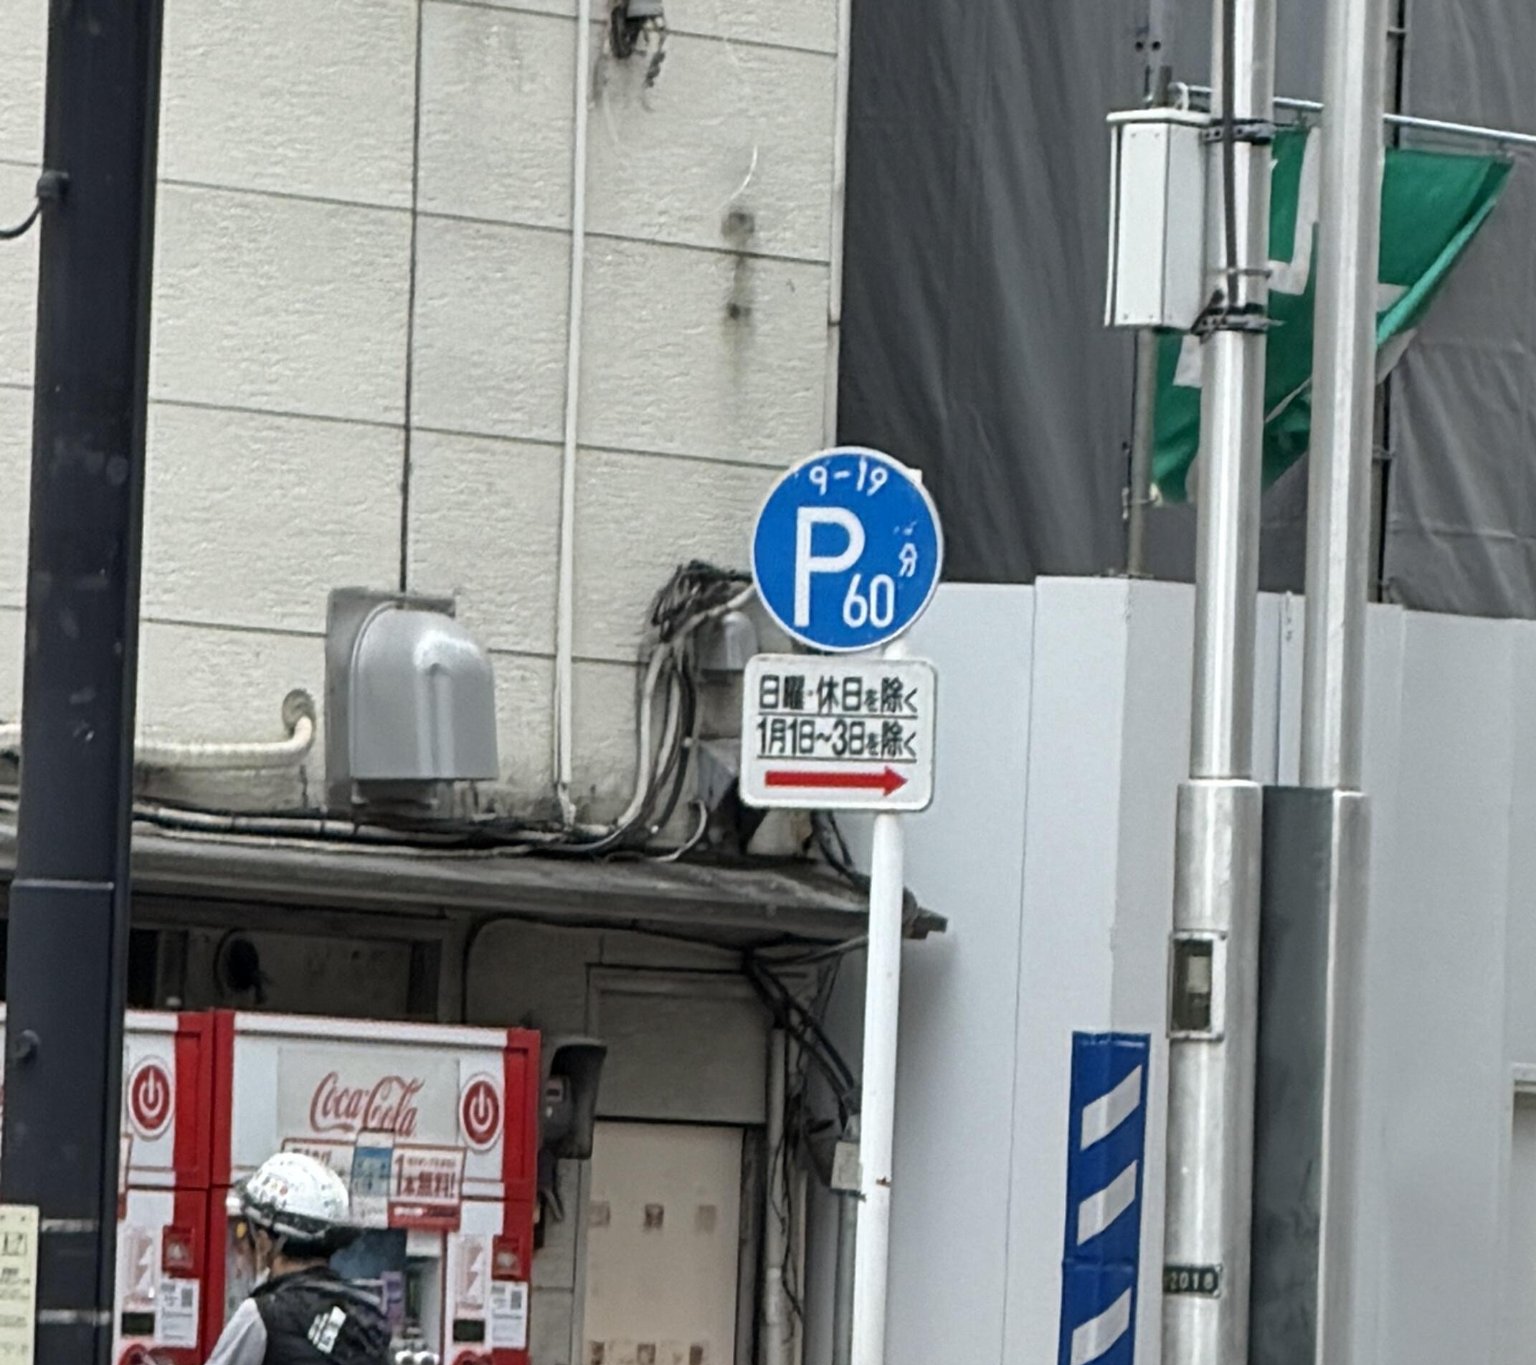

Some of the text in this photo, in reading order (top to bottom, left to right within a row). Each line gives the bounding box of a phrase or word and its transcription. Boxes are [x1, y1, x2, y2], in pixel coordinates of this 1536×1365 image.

[808, 457, 889, 497] 9-19
[793, 506, 866, 627] P
[842, 573, 896, 629] 60
[758, 674, 918, 715] 日曜・休日を除く
[309, 1071, 427, 1138] Coca-Cola
